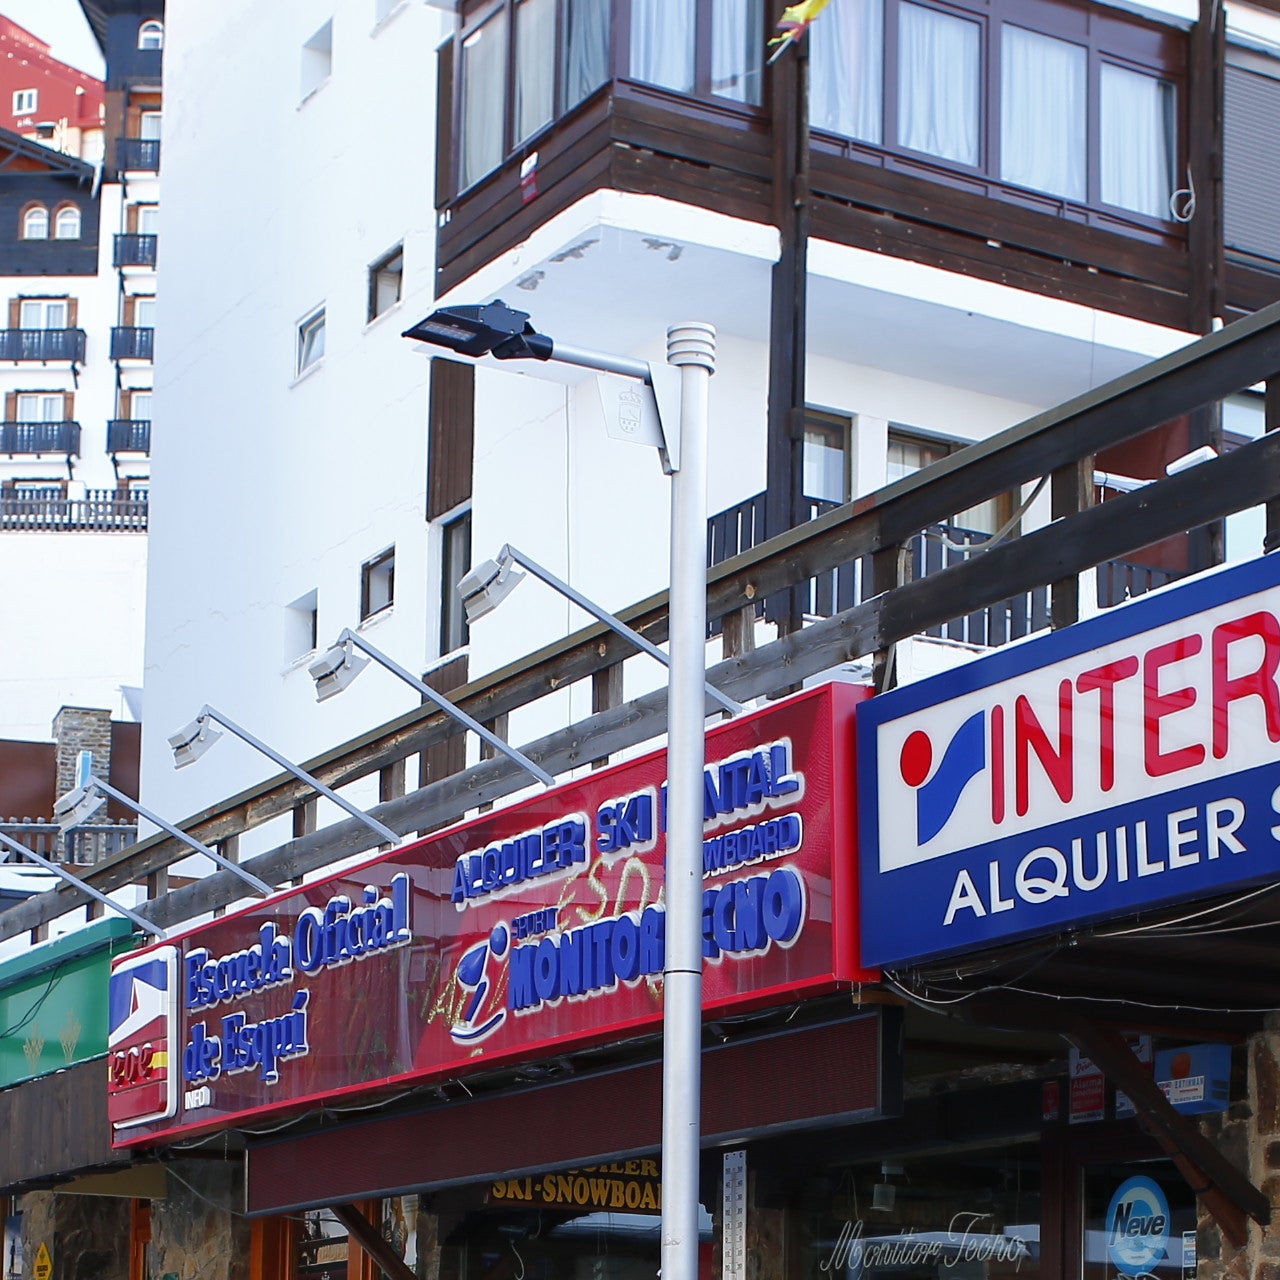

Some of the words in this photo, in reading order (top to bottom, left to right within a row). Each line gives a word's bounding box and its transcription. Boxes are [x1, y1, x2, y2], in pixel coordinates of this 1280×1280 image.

[451, 811, 591, 912] ALQUILER
[596, 784, 660, 856] SKI
[660, 736, 807, 834] NTAL
[943, 797, 1247, 926] ALQUILER
[184, 921, 295, 1013] Escuela
[294, 871, 412, 977] Oficial
[511, 905, 562, 940] SPORT
[701, 864, 806, 966] ECNO
[183, 1020, 222, 1086] de
[220, 987, 311, 1086] Esquí
[184, 1086, 211, 1110] INFO
[1109, 1201, 1166, 1246] Neve
